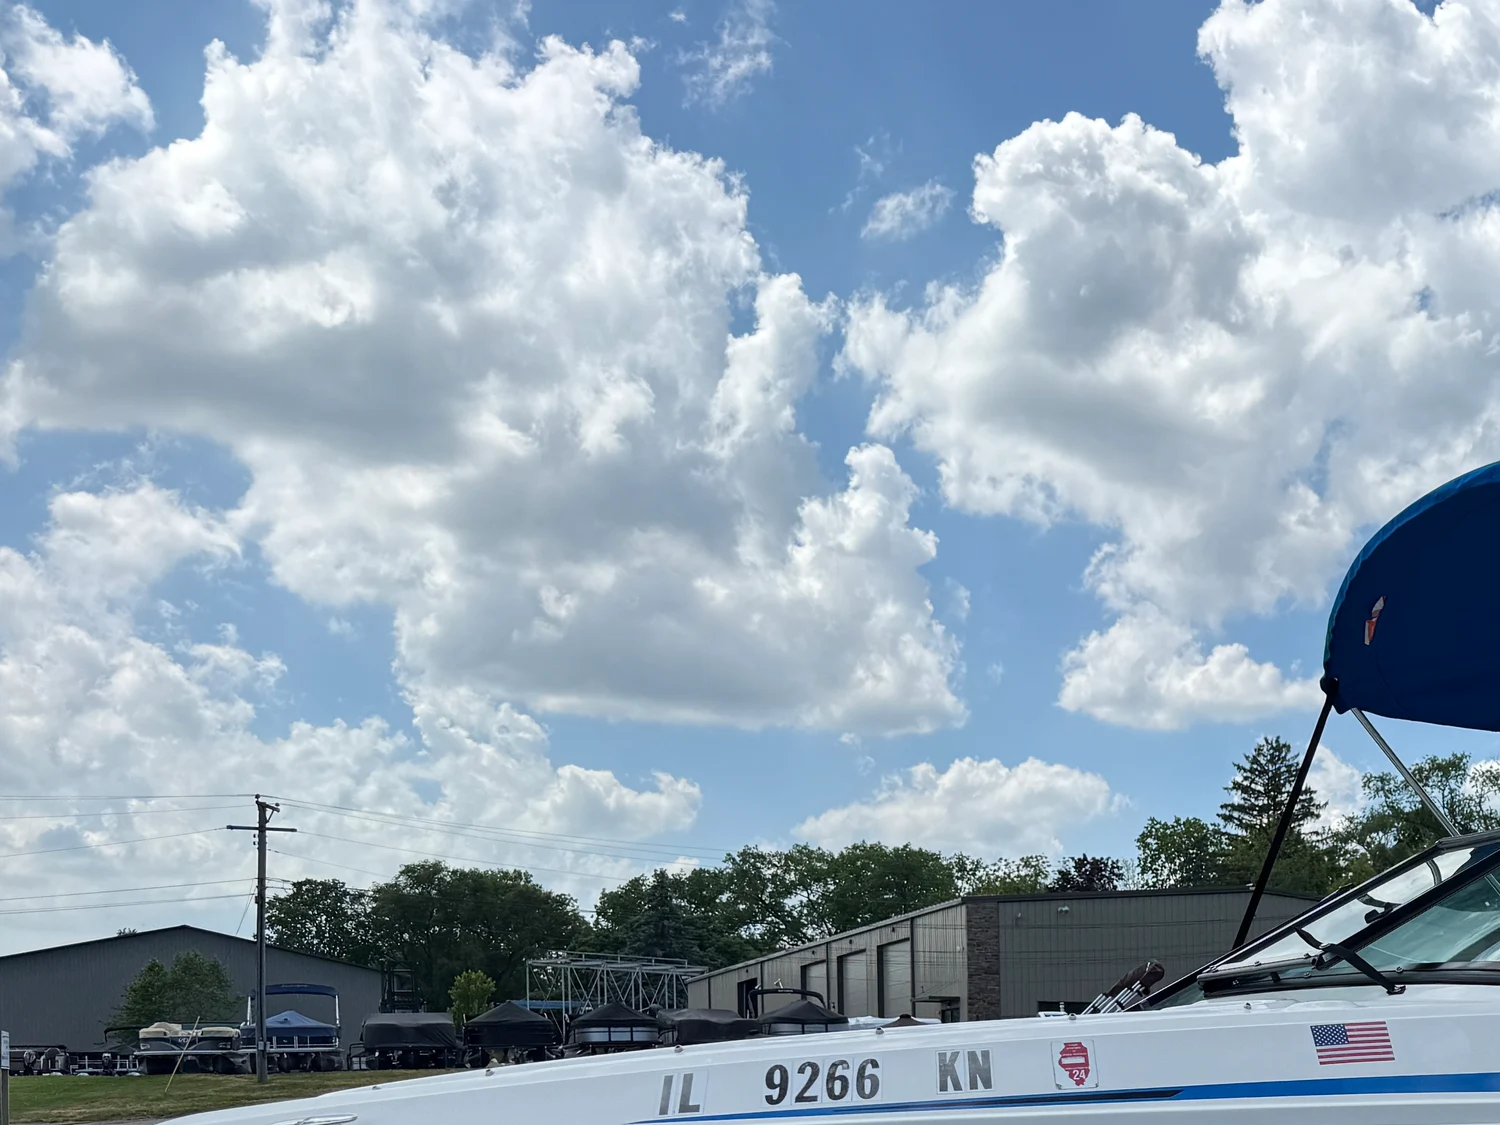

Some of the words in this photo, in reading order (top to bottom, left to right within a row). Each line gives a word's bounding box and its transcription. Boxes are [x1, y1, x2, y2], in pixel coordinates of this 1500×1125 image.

[659, 1073, 702, 1115] IL
[764, 1058, 881, 1106] 9266
[938, 1049, 993, 1092] KN
[1072, 1069, 1086, 1080] 24
